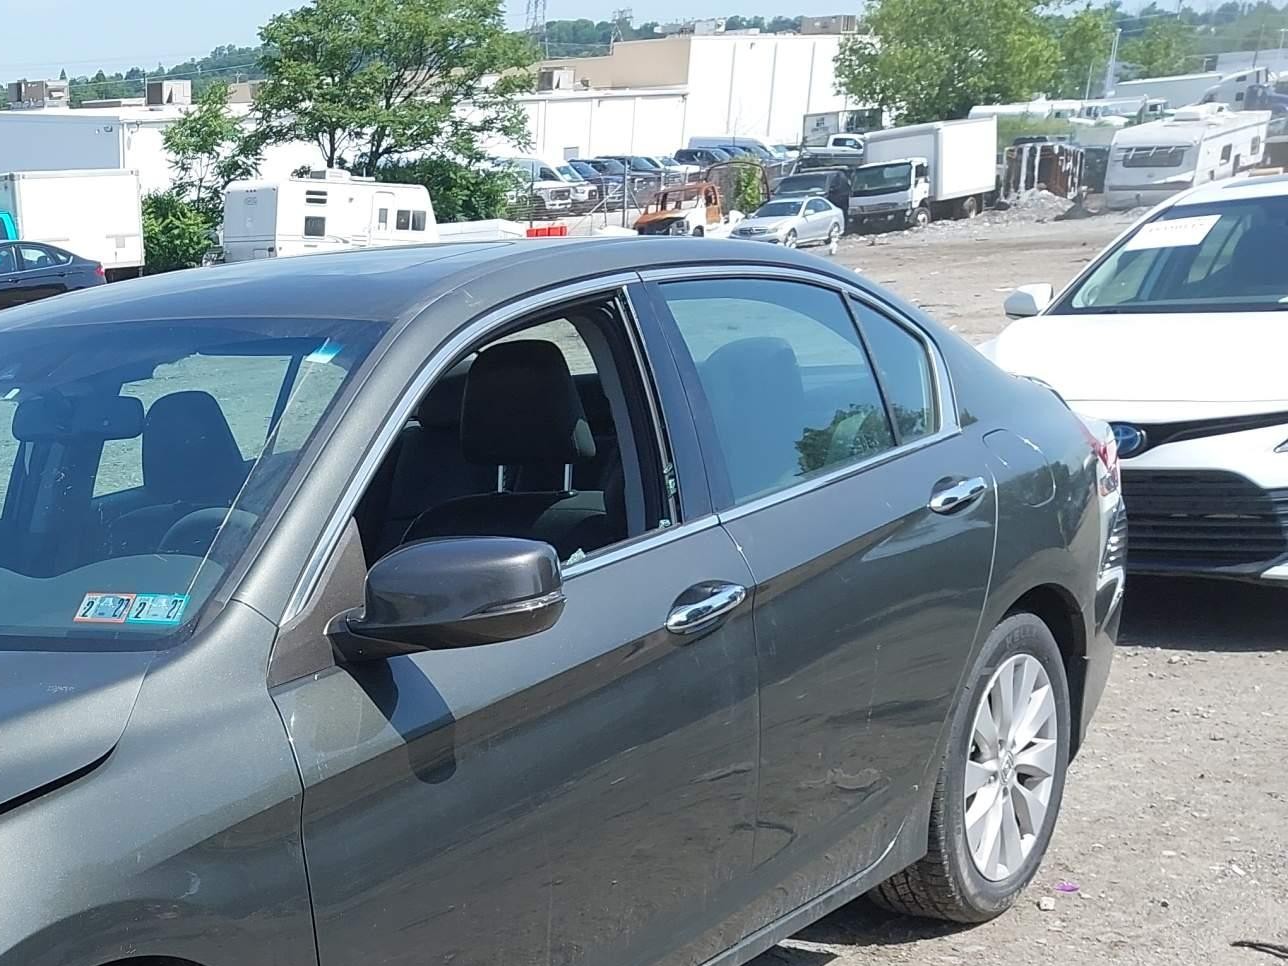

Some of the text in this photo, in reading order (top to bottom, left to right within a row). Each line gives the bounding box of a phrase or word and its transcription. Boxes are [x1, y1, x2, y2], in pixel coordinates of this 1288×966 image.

[81, 598, 130, 619] 2 27
[134, 599, 184, 620] 2 27
